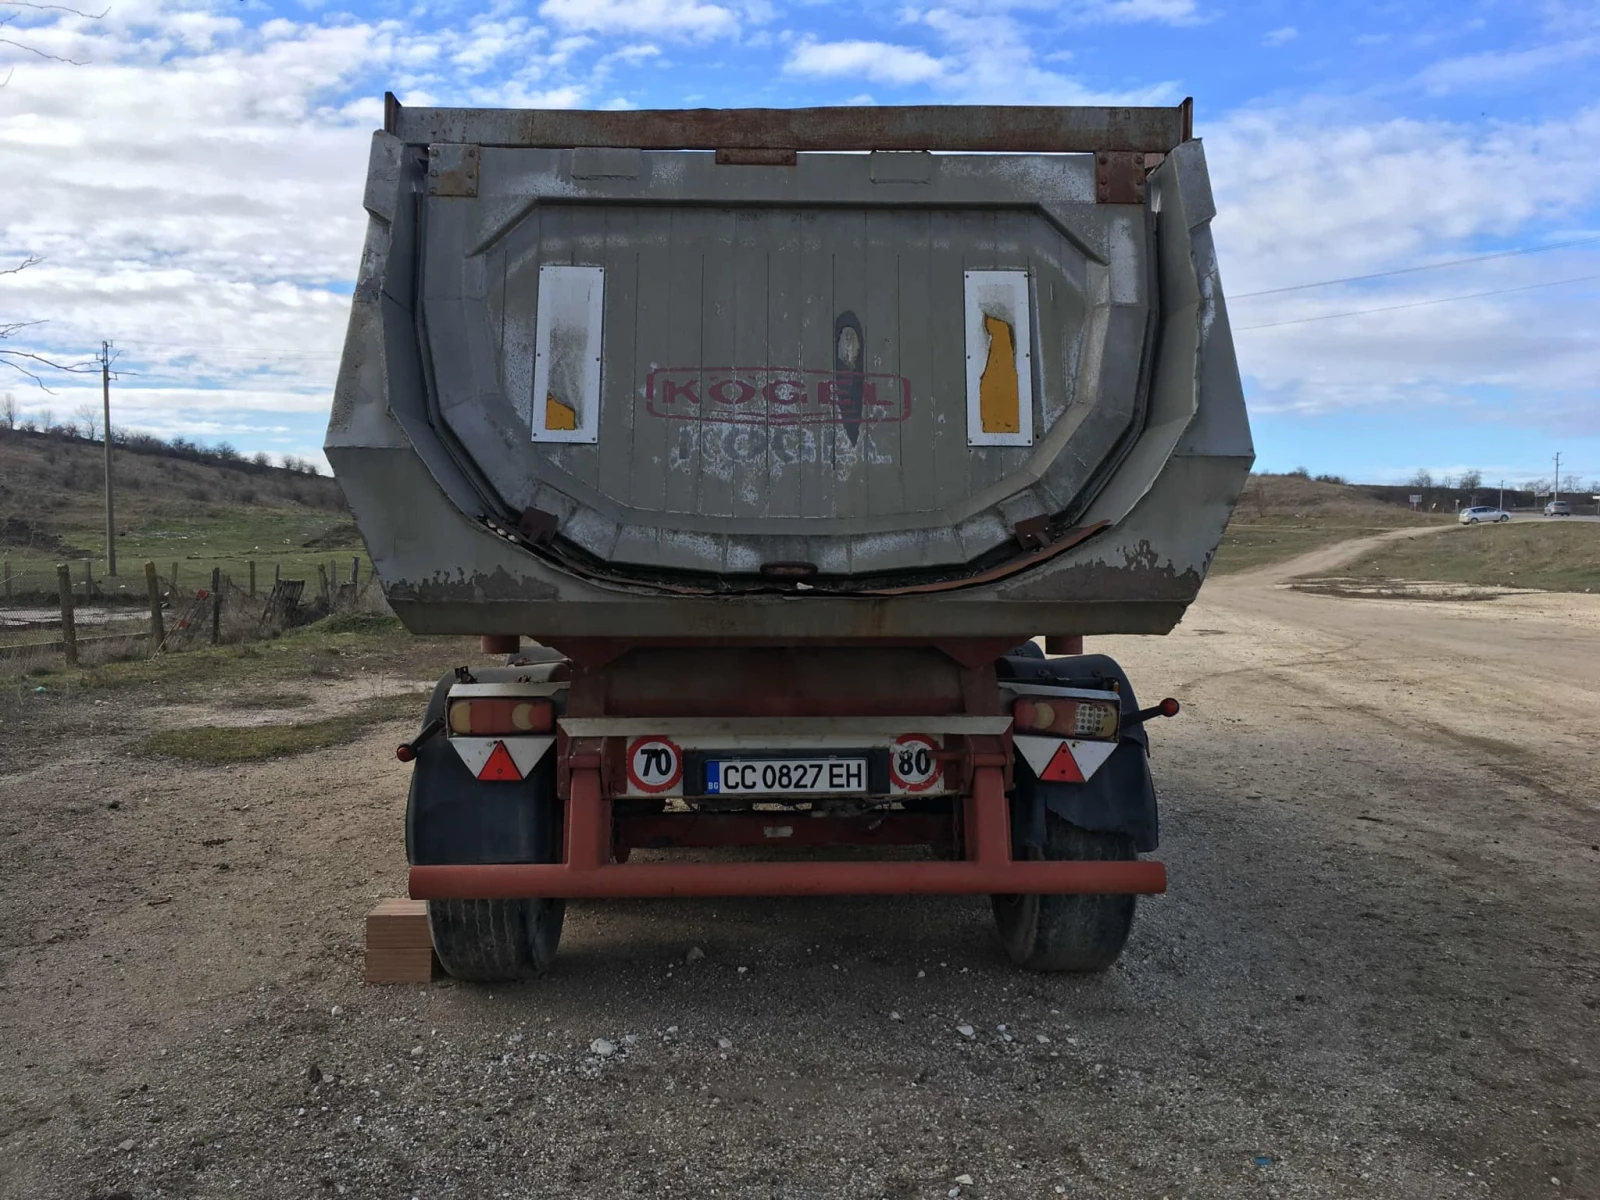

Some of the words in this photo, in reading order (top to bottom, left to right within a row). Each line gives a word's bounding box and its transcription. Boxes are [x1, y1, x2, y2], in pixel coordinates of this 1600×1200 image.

[640, 748, 672, 777] 70
[898, 748, 931, 775] 80
[707, 781, 719, 790] BG
